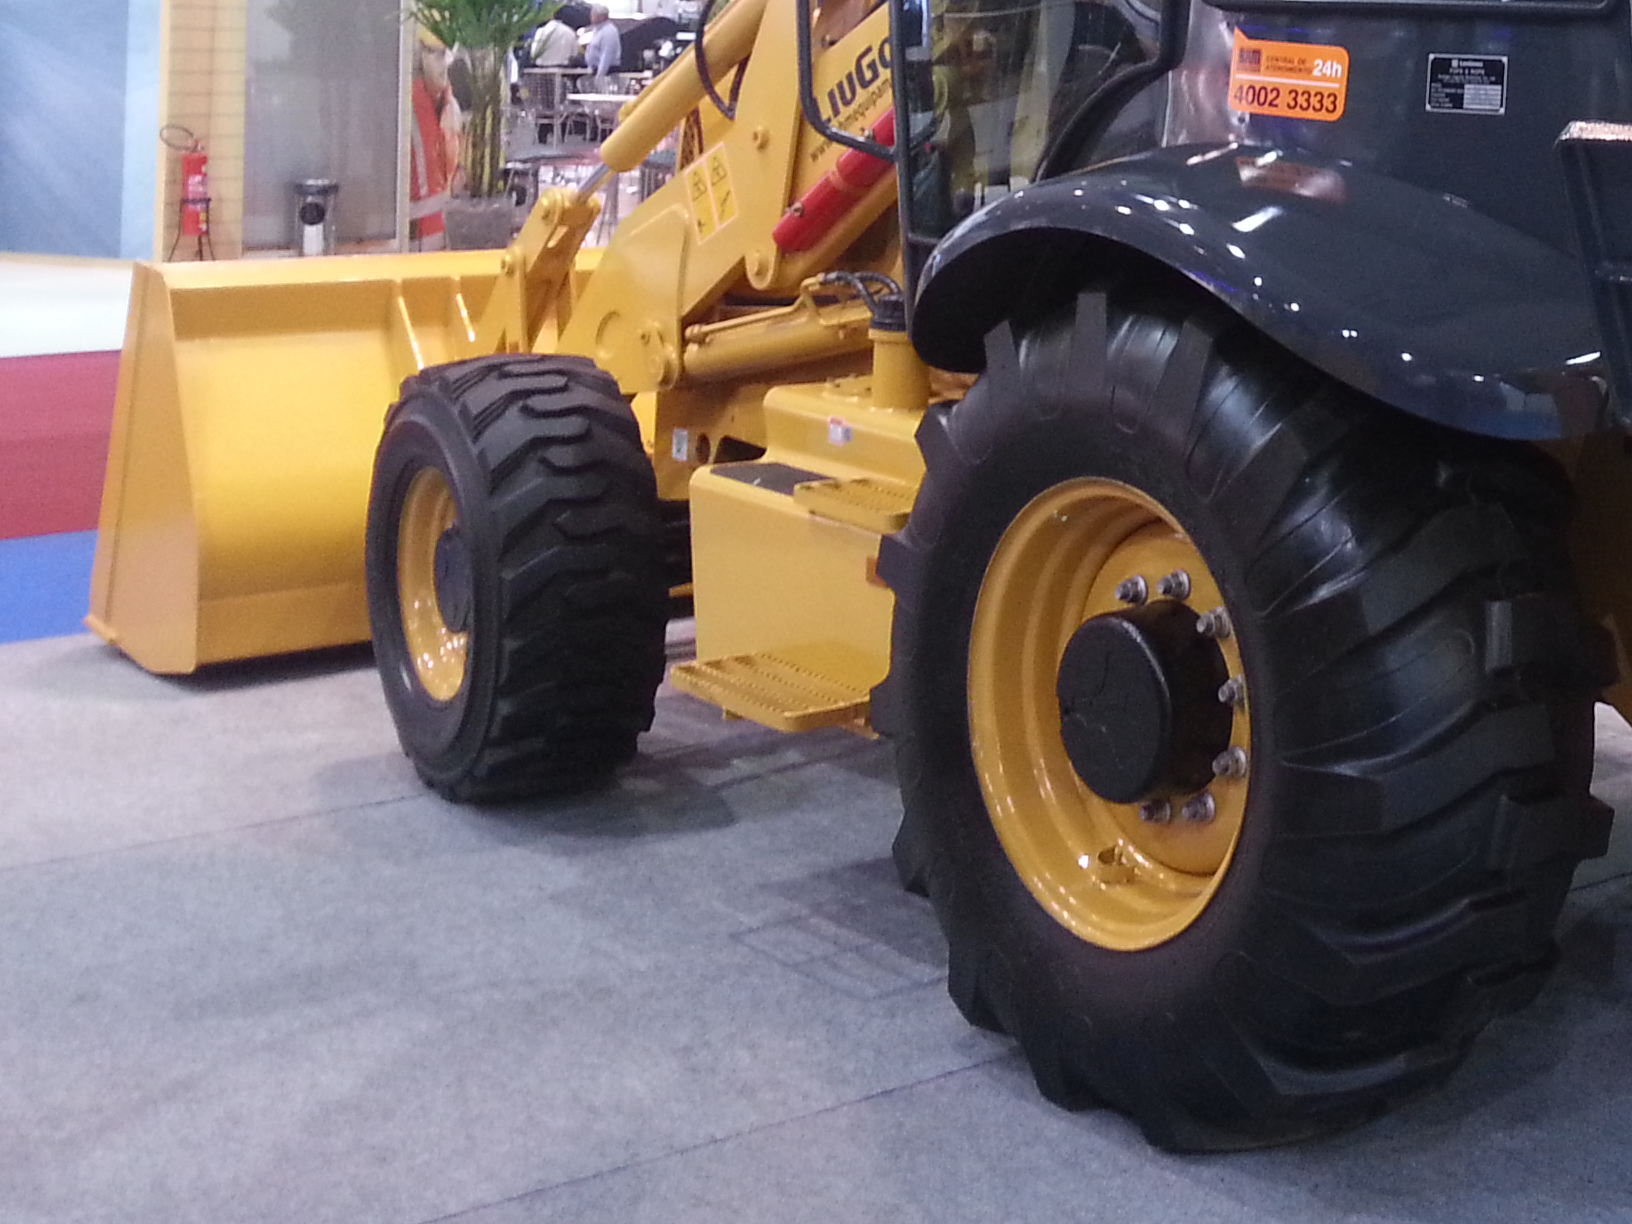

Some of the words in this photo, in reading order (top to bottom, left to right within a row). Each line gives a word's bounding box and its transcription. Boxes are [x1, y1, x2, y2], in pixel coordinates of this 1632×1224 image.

[1312, 59, 1343, 78] 24h
[1234, 85, 1281, 108] 4002
[1286, 89, 1338, 114] 3333
